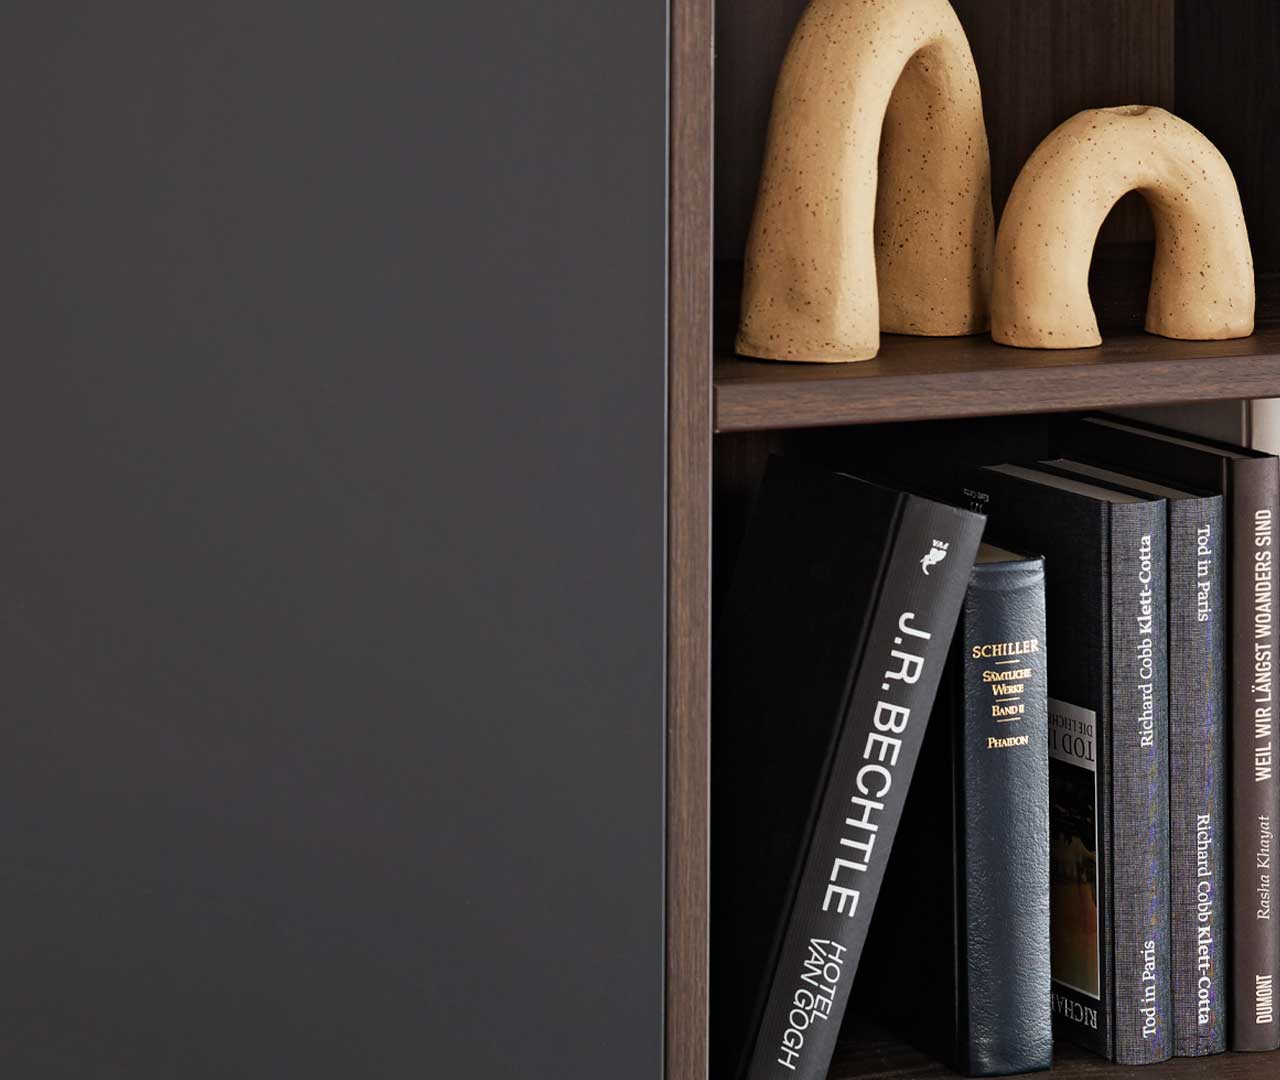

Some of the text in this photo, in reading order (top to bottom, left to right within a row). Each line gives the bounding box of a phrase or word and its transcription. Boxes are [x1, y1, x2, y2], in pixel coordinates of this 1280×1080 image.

[1197, 524, 1212, 622] Tod in Paris
[972, 639, 1040, 659] SCHILLER
[1137, 534, 1154, 748] Richard Cobb Klett-Cotta
[1251, 508, 1272, 782] WEIL WIR LÄNGST WOANDERS SIND
[987, 735, 1030, 749] PHAIDON
[1062, 732, 1095, 762] TOD
[822, 700, 911, 918] BECHTLE
[1256, 815, 1274, 920] Rasha Khayat
[1196, 813, 1212, 1024] Richard Cobb Klett-Cotta
[777, 938, 830, 1070] VAN GOGH
[809, 941, 847, 1024] HOTEL
[1140, 940, 1157, 1039] Tod in Paris
[1255, 974, 1273, 1025] DUMONT
